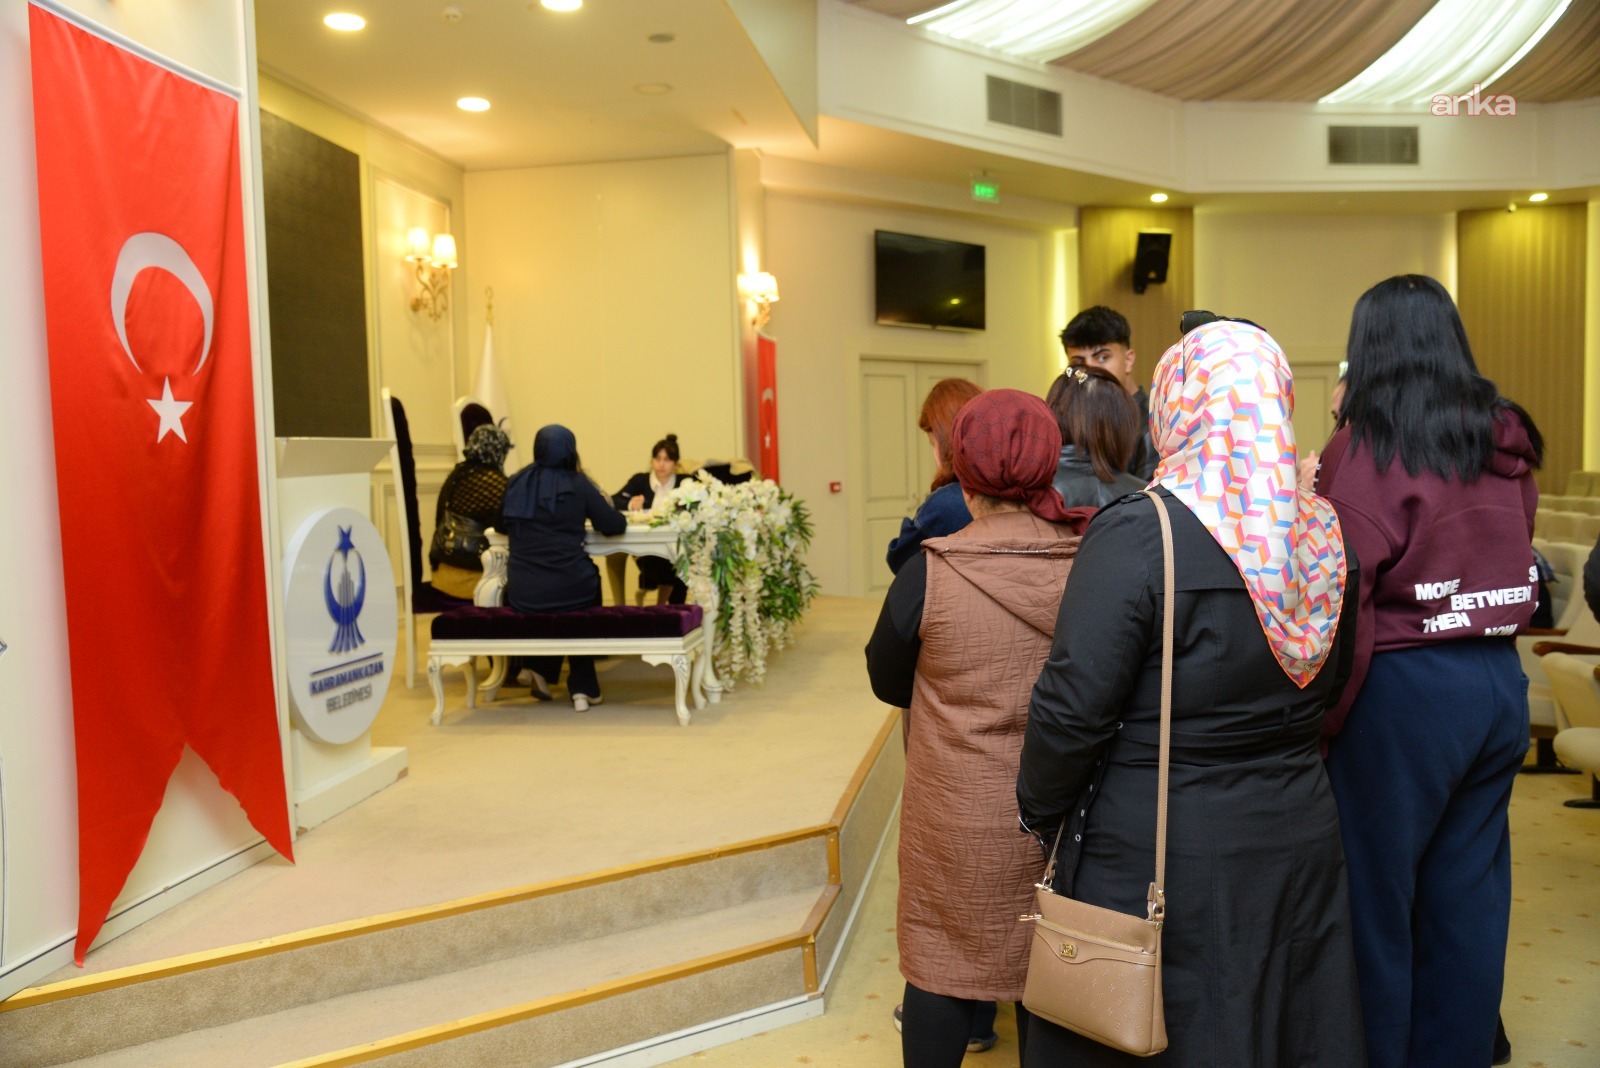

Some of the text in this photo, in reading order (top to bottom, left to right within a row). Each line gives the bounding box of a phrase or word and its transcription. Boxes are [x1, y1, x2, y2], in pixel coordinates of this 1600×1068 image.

[1414, 578, 1461, 600] MORE
[1450, 585, 1532, 611] BETWEEN
[1422, 612, 1472, 633] THEN
[310, 661, 384, 696] KAHRAMANKAZAN
